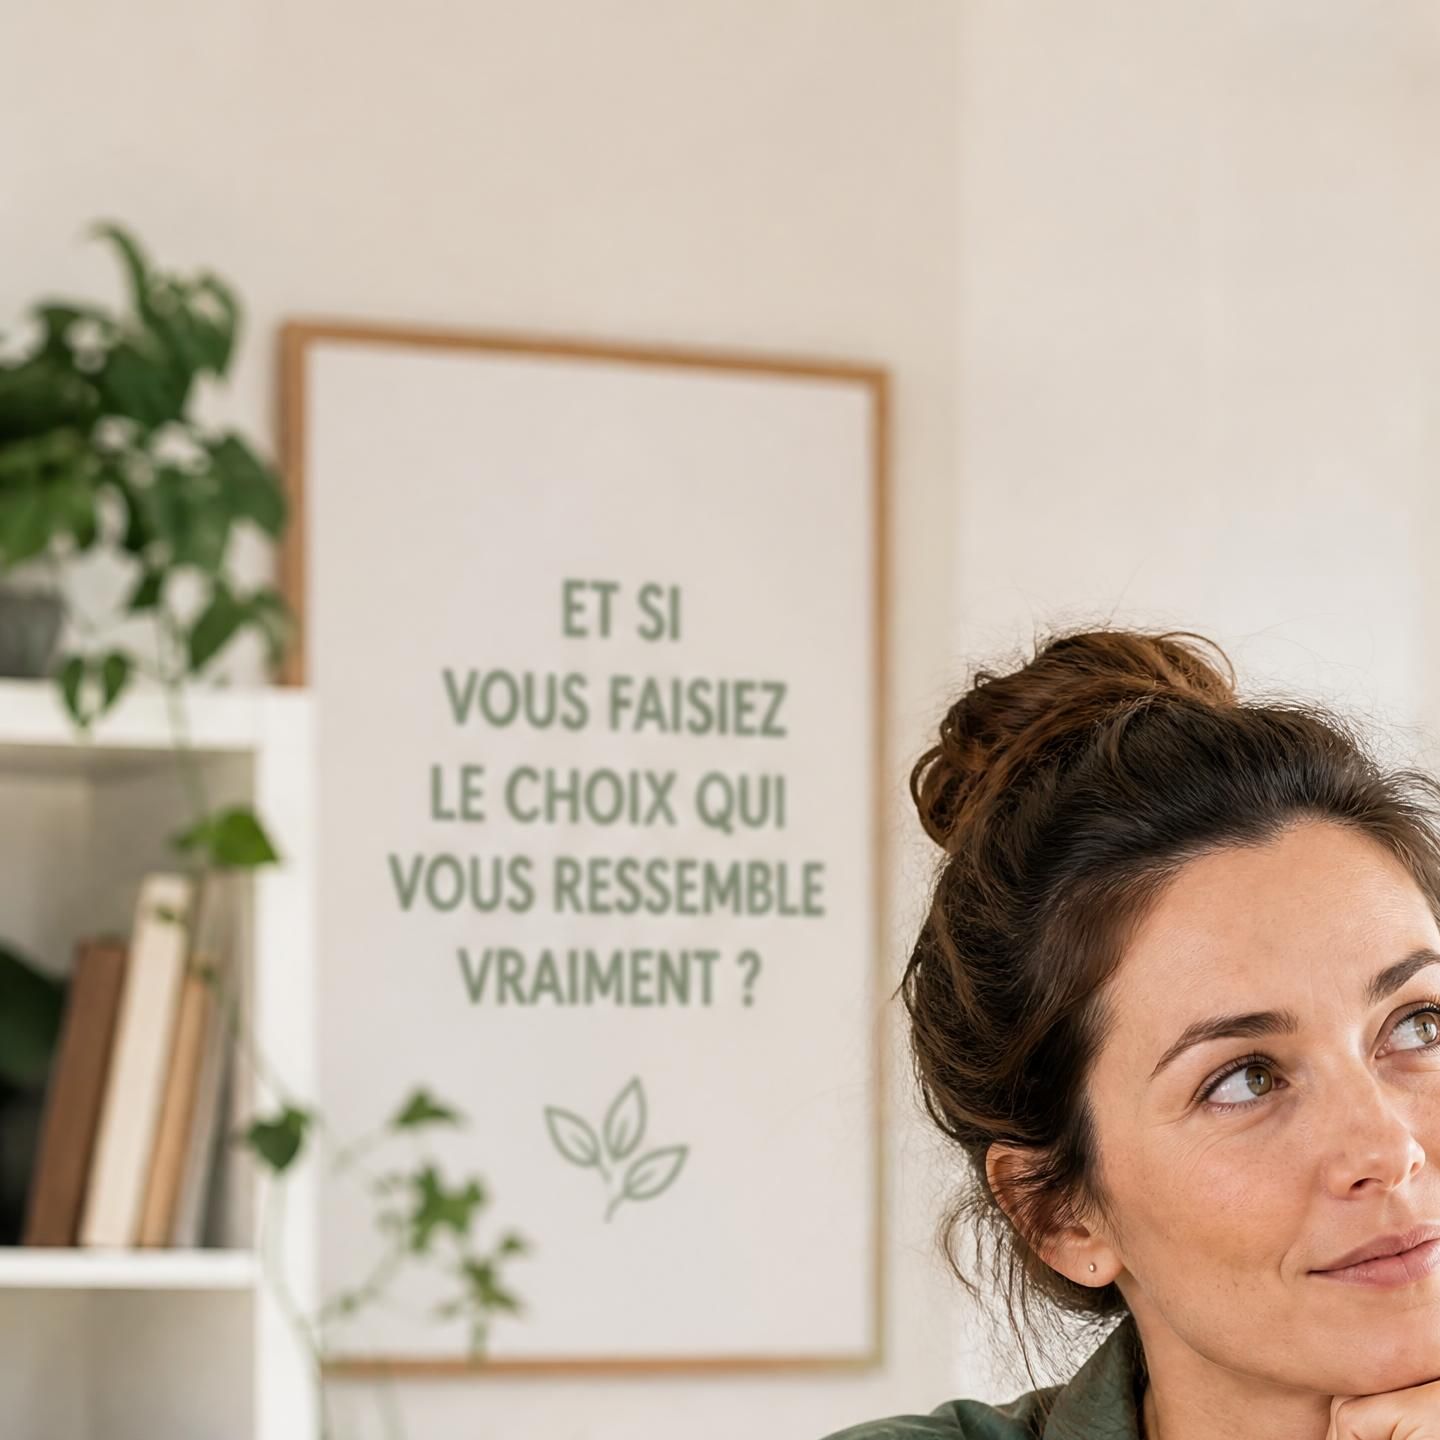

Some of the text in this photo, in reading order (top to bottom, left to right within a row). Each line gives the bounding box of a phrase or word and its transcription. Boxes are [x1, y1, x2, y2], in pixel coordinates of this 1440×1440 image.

[561, 578, 681, 643] ET SI
[442, 668, 788, 739] VOUS FAISIEZ
[430, 763, 786, 836] LE CHOIX QUI
[387, 852, 825, 918] VOUS RESSEMBLE
[457, 947, 763, 1008] VRAIMENT ?
